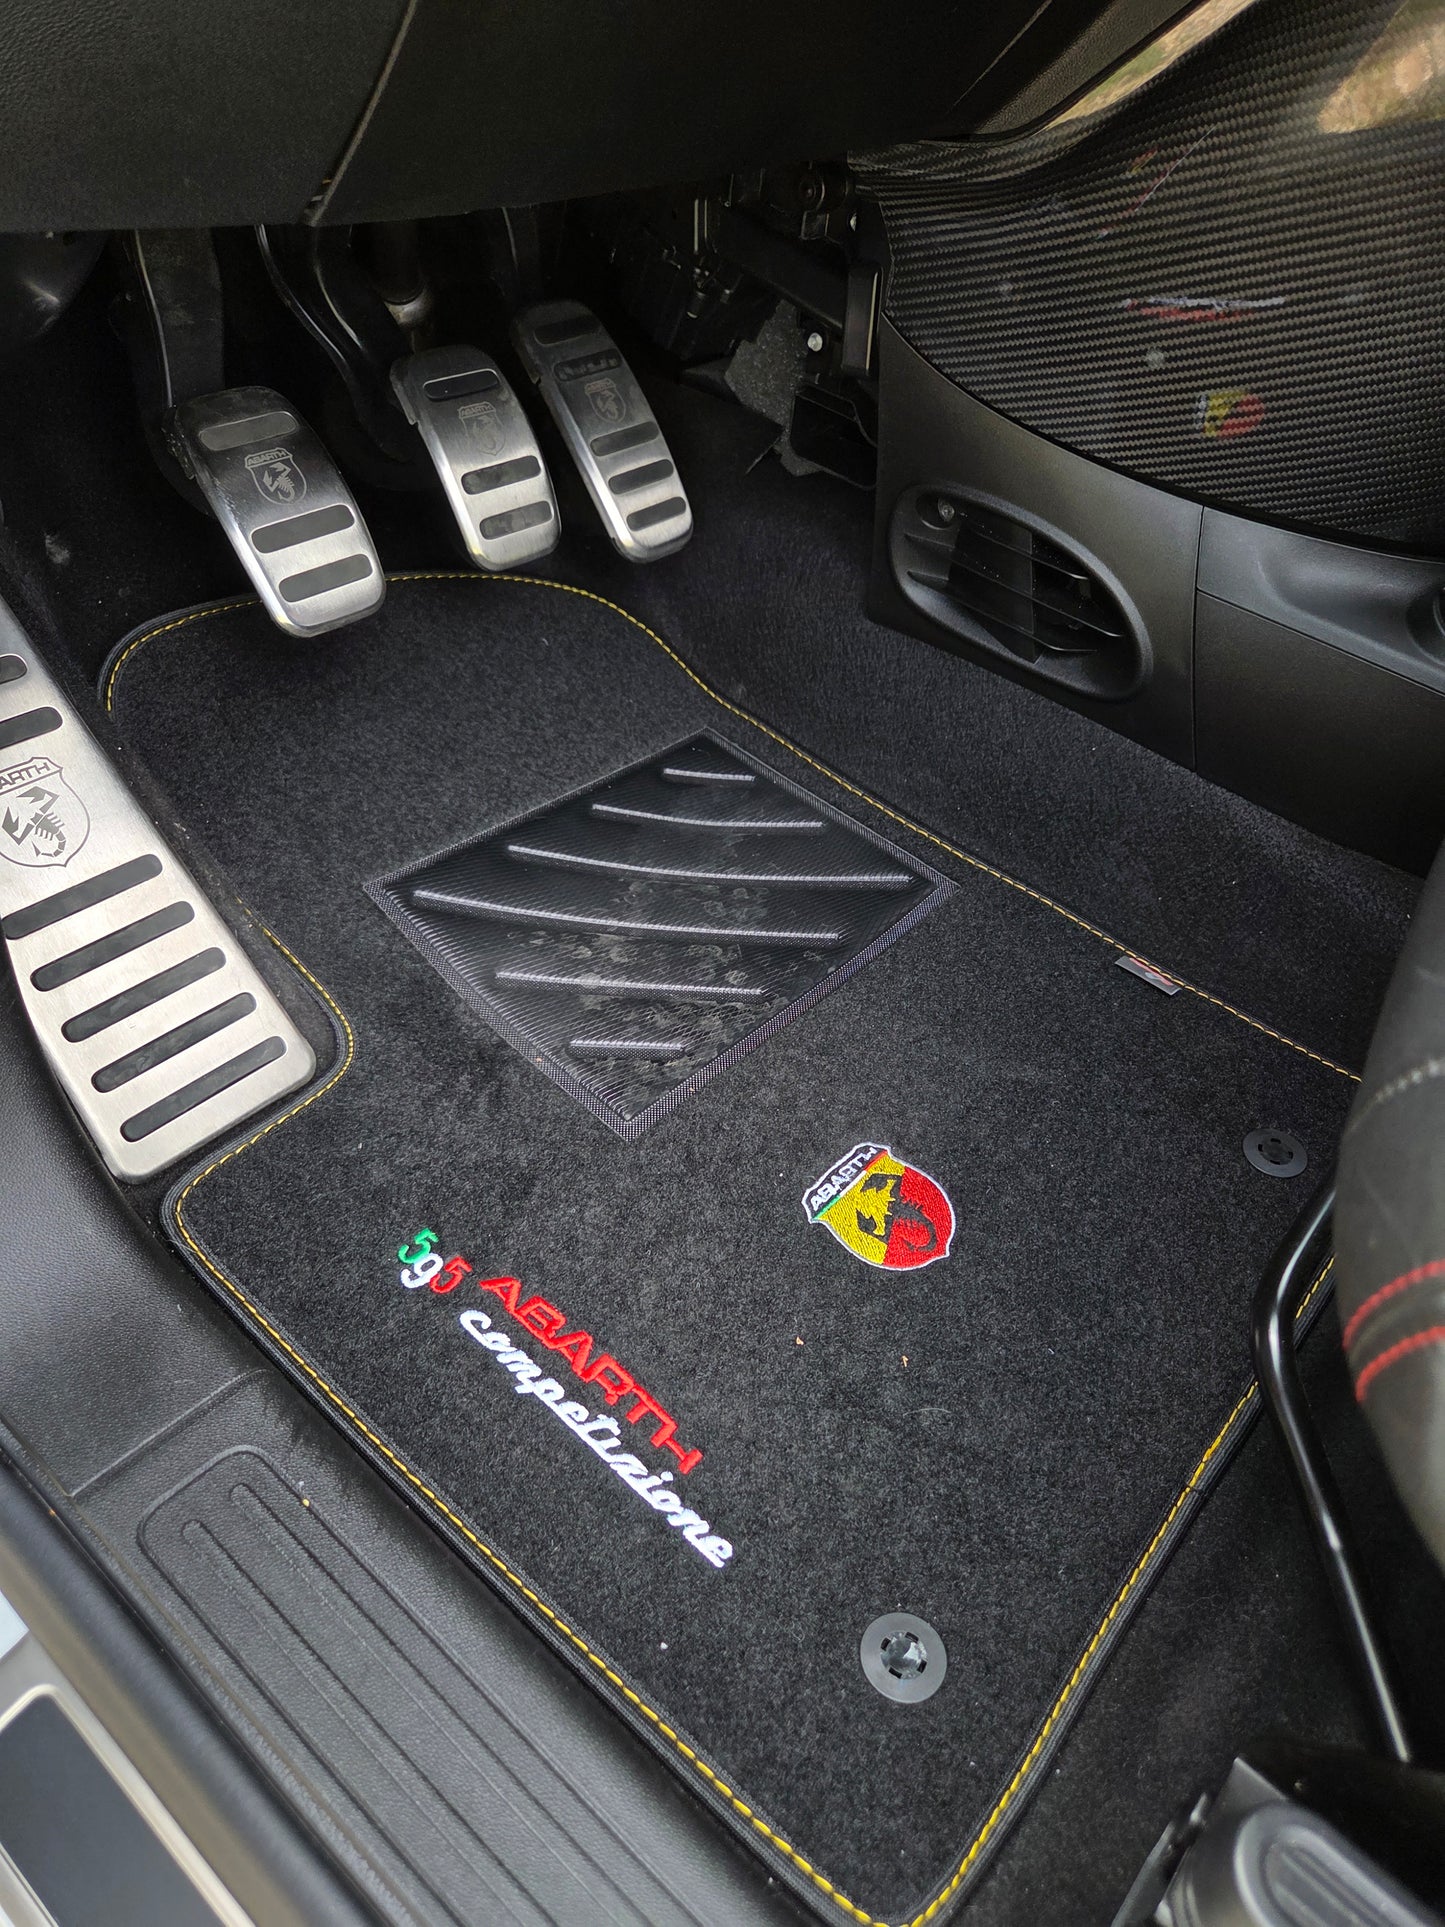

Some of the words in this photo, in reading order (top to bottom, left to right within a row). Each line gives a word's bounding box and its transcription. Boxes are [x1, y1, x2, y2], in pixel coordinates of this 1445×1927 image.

[247, 451, 287, 466] ABARTH
[810, 1147, 878, 1211] ABARTH
[398, 1227, 473, 1294] 595
[478, 1275, 703, 1475] ABARTH
